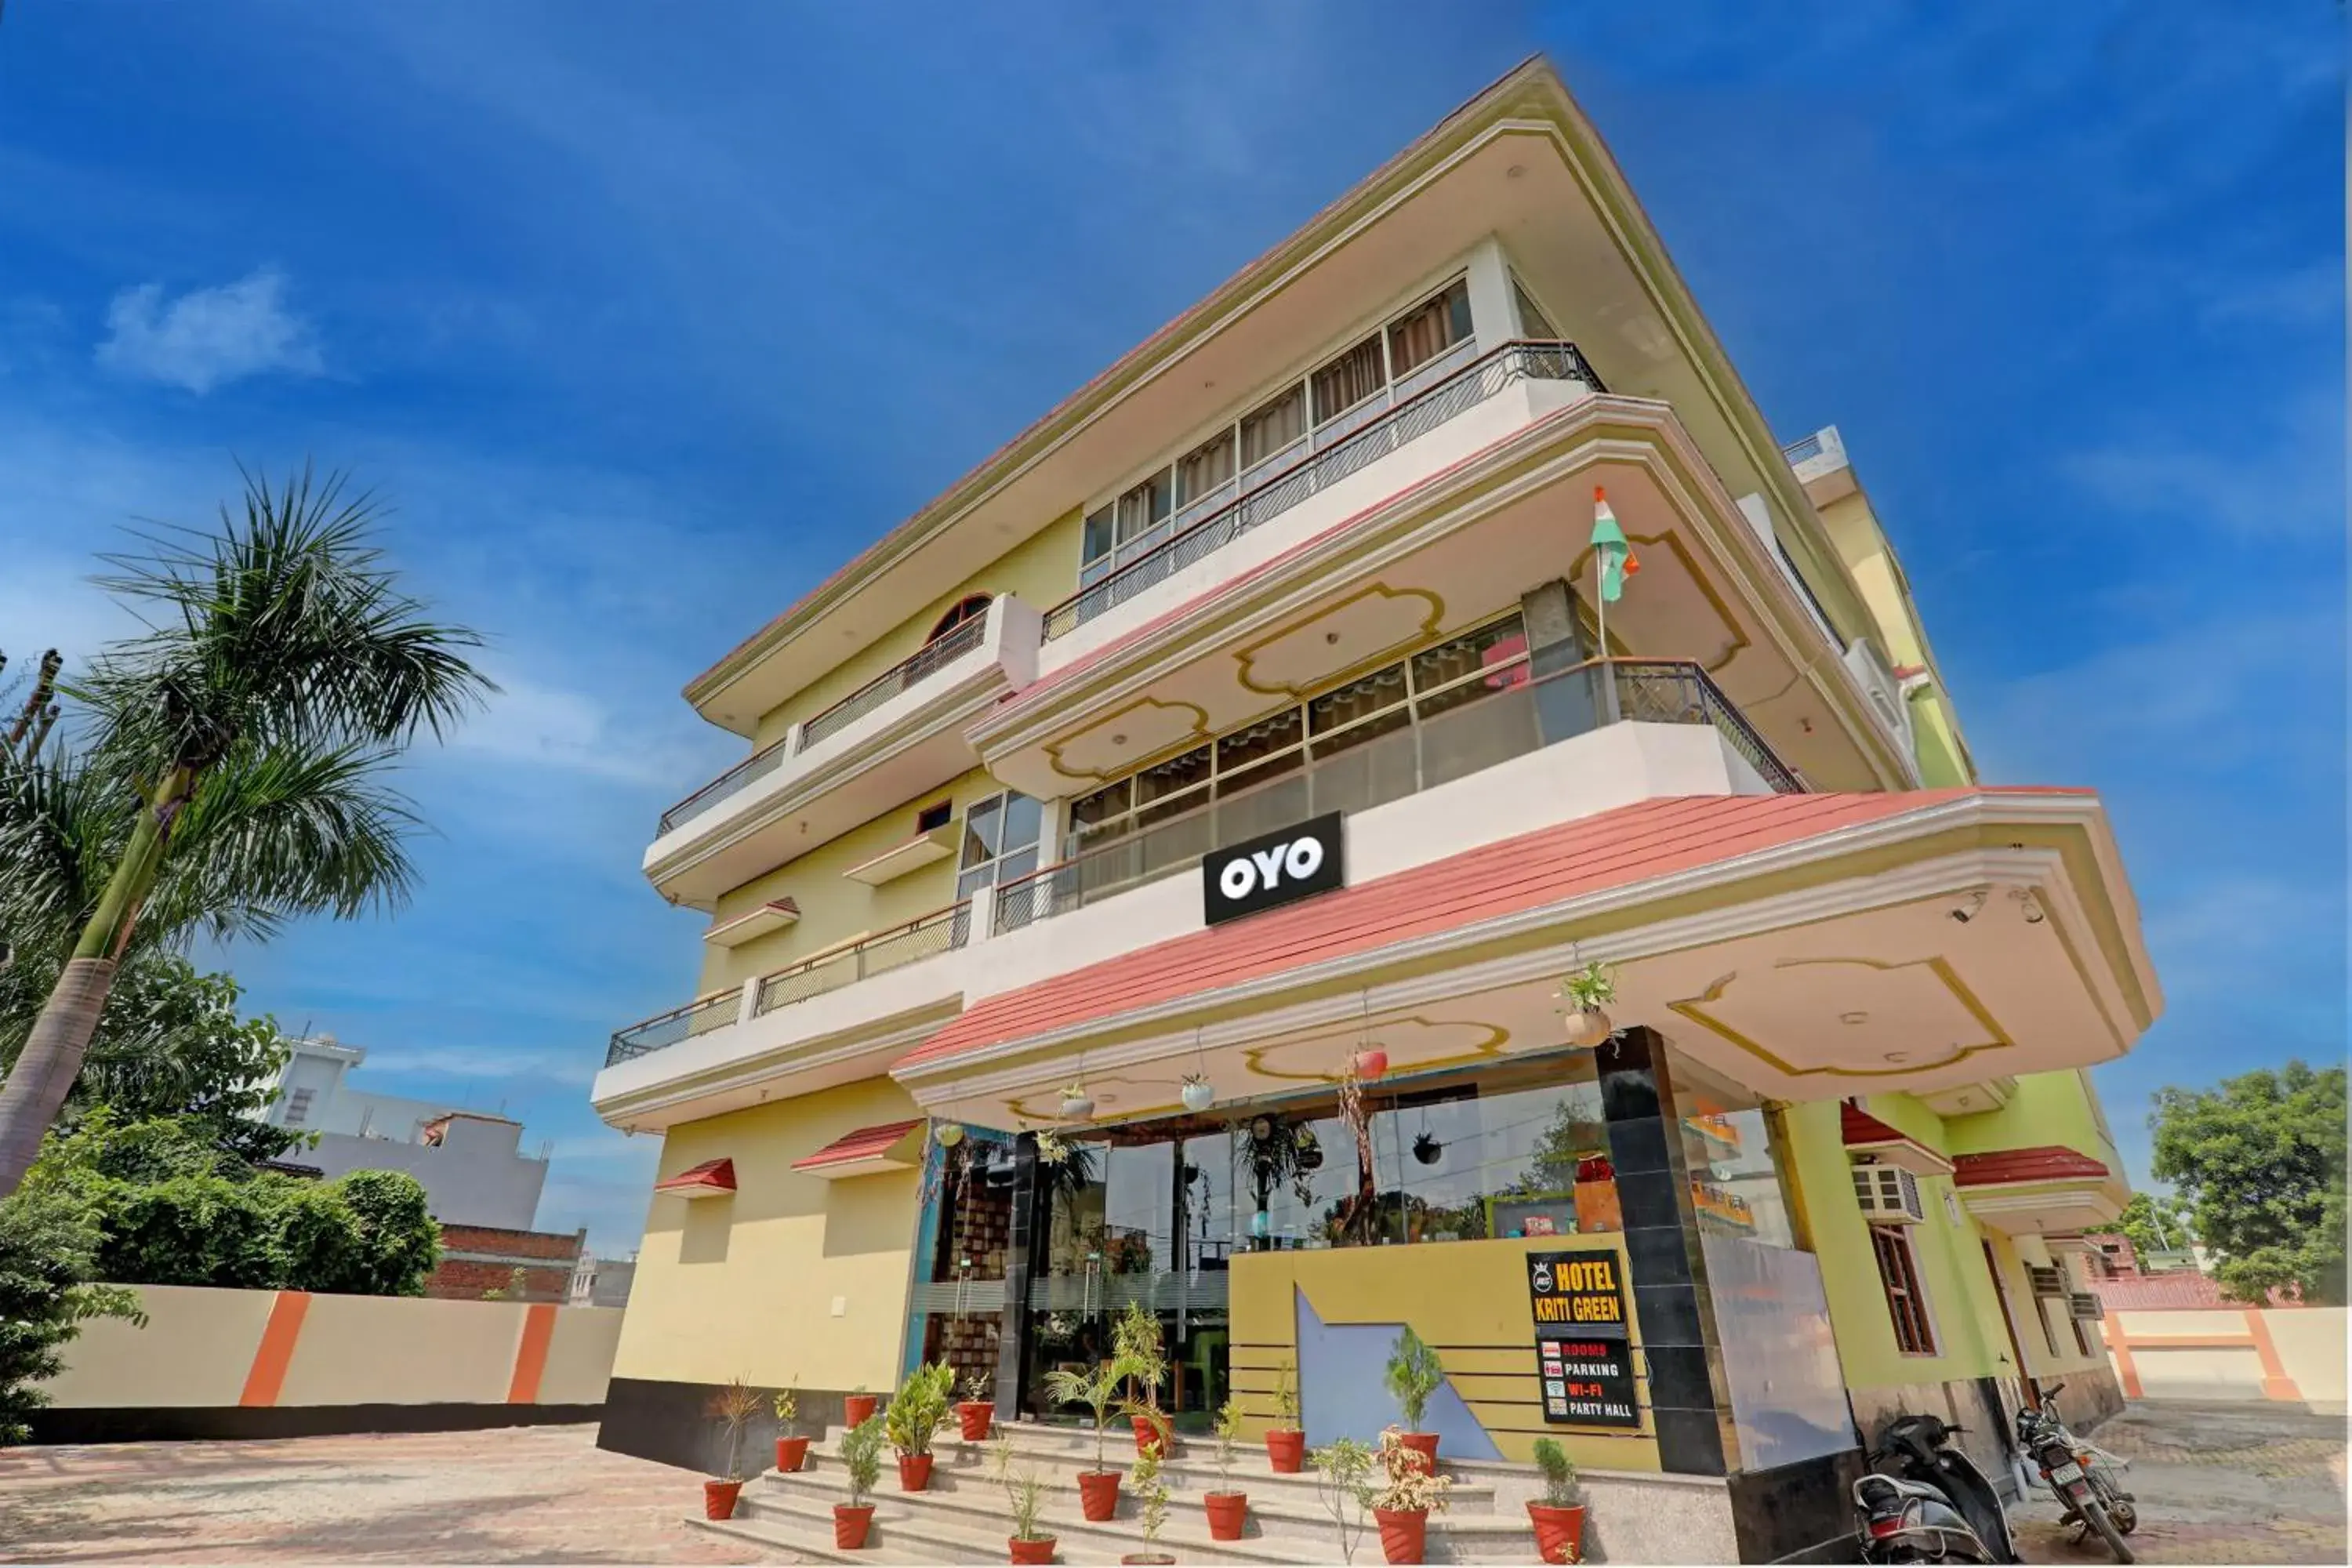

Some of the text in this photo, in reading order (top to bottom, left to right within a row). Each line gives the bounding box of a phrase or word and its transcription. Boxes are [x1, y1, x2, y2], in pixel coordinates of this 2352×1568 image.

[1220, 837, 1323, 899] OYO
[1555, 1261, 1616, 1291] HOTEL
[1535, 1296, 1620, 1321] KRITI GREEN
[1563, 1344, 1606, 1356] ROOMS
[1565, 1363, 1618, 1377] PARKING
[1568, 1383, 1602, 1397] WI-FI
[1570, 1402, 1632, 1417] PARTY HALL
